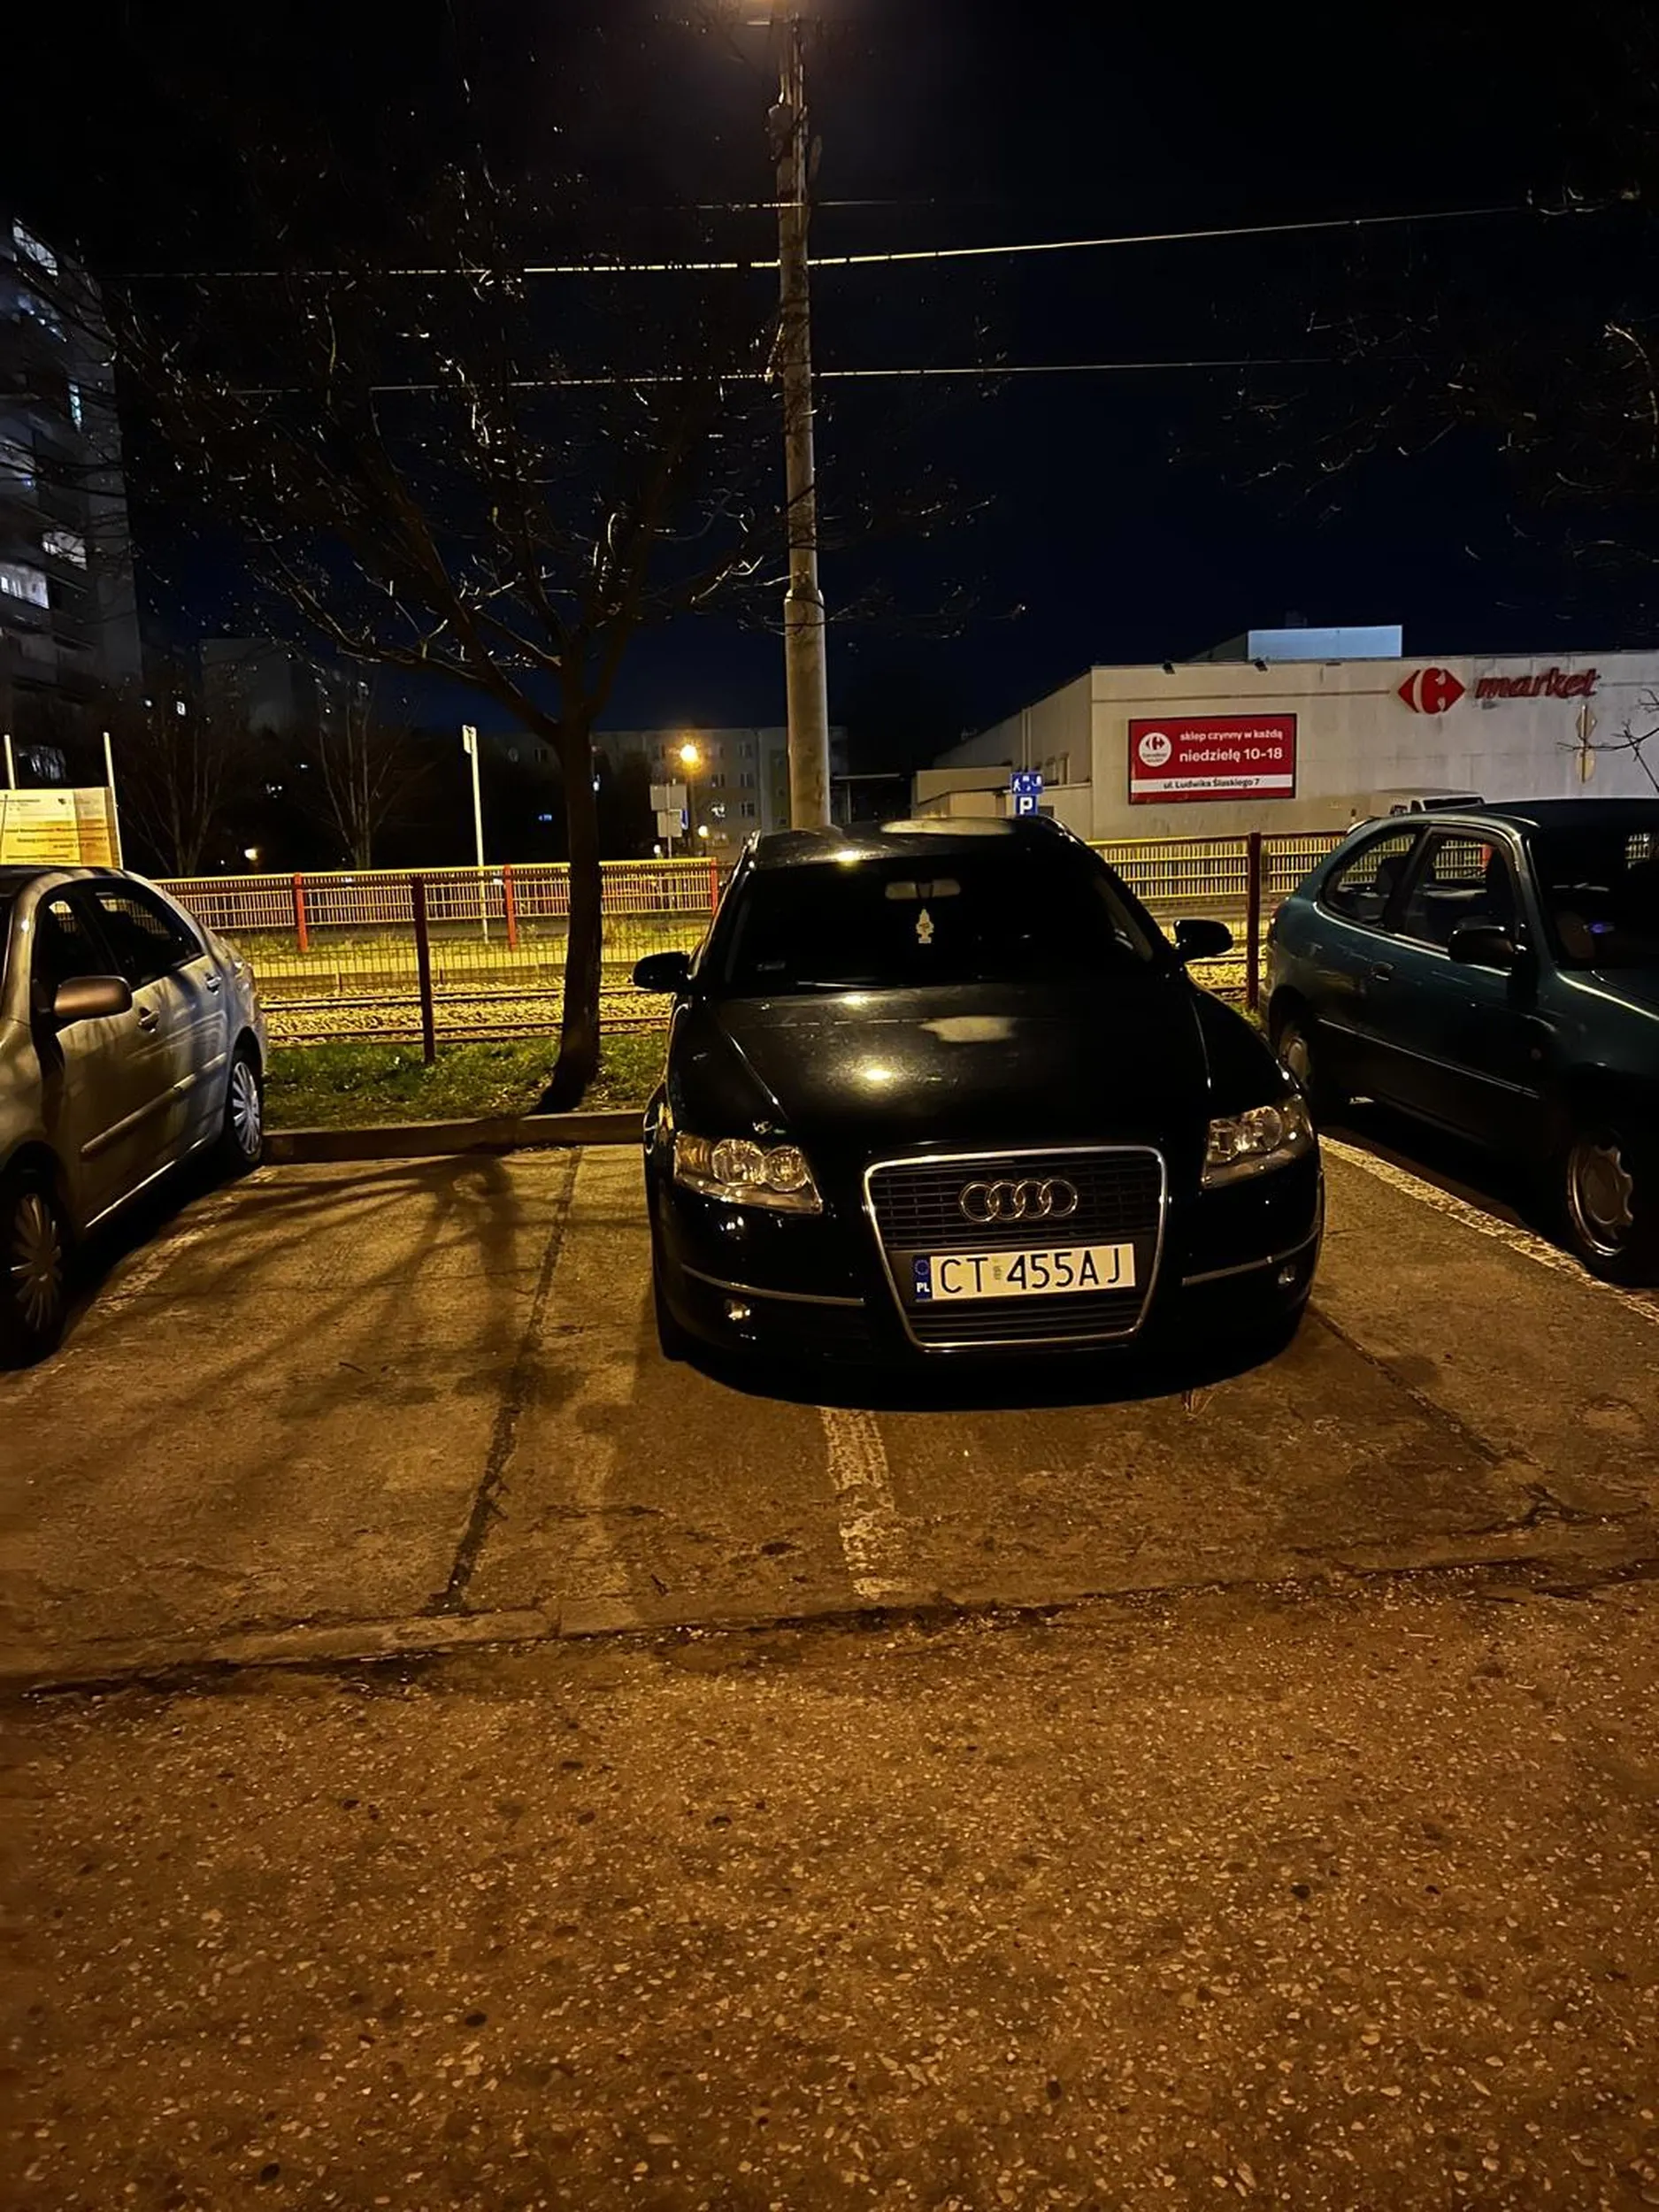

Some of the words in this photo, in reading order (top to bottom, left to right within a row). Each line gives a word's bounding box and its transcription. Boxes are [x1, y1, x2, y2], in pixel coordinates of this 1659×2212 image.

[1475, 667, 1601, 699] market
[1179, 731, 1207, 742] sklep
[1208, 732, 1243, 741] czynny
[1253, 729, 1283, 741] każdą
[1179, 748, 1240, 763] niedzielę
[1243, 747, 1283, 760] 10-18
[1175, 780, 1212, 788] Ludwika
[1019, 796, 1033, 815] P
[940, 1256, 989, 1294] CT
[1006, 1248, 1120, 1290] 455AJ
[916, 1282, 930, 1293] PL
